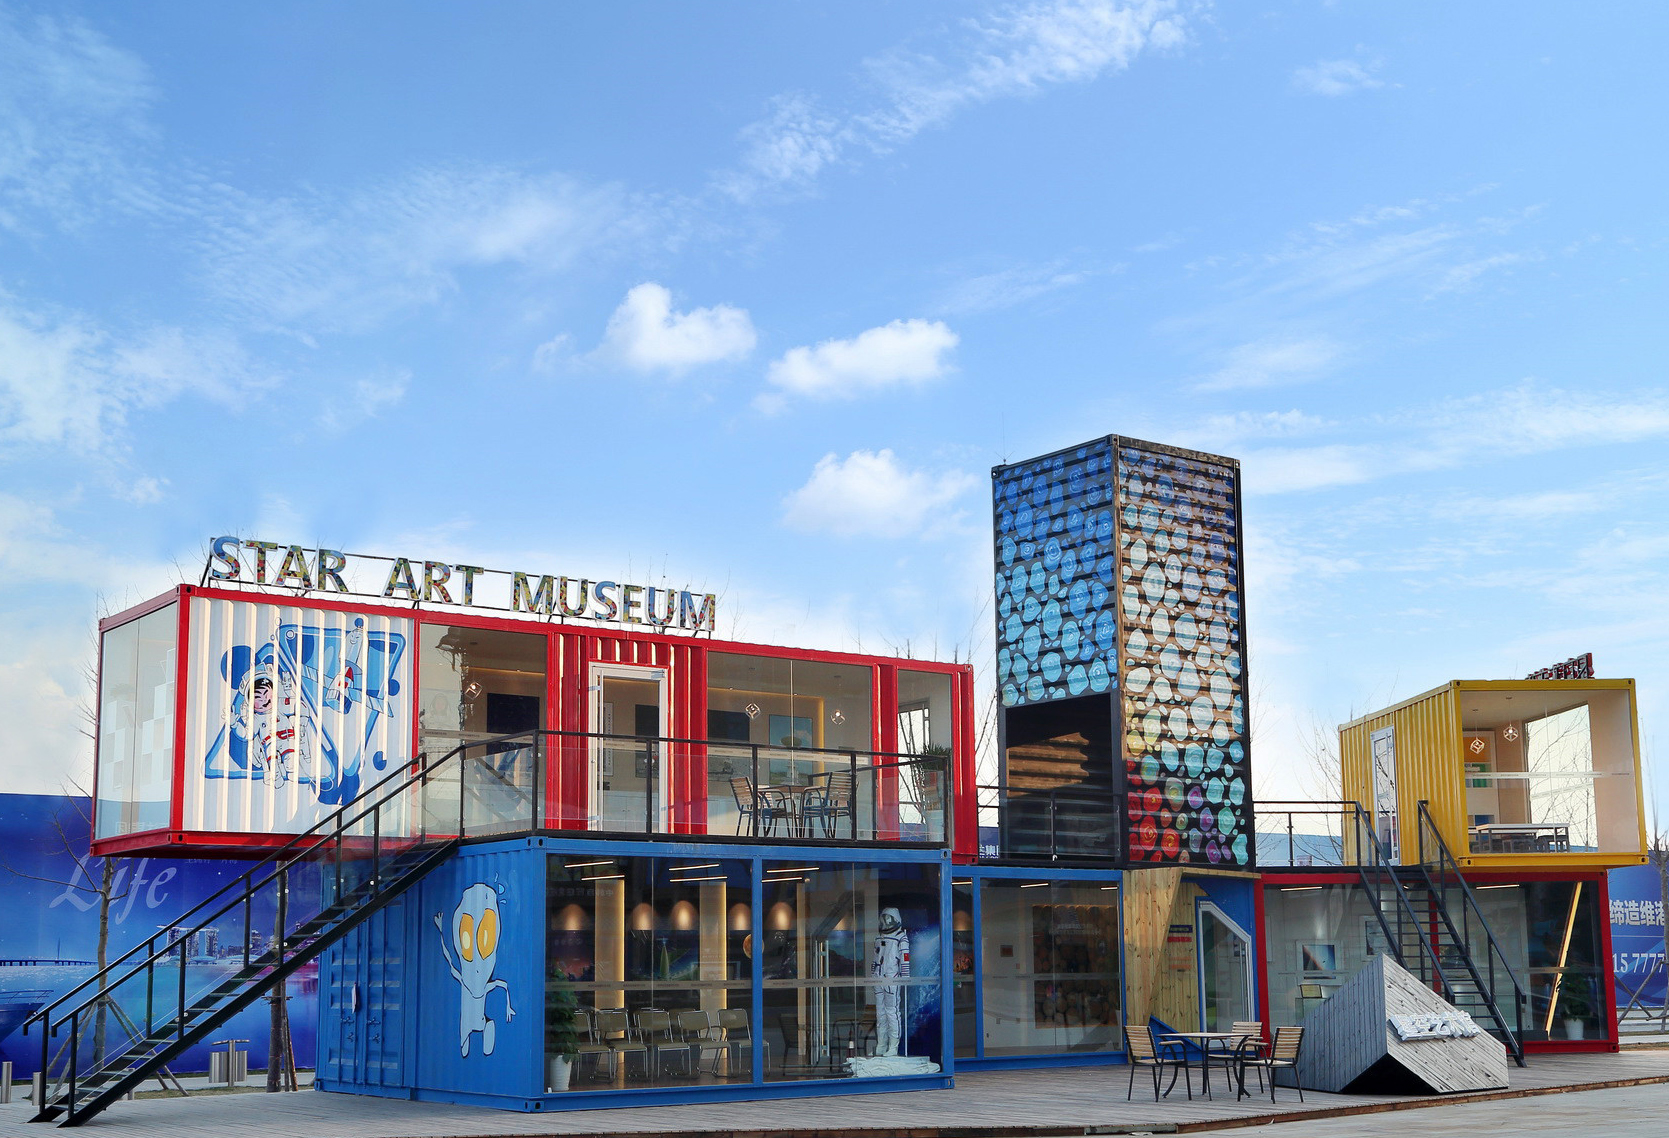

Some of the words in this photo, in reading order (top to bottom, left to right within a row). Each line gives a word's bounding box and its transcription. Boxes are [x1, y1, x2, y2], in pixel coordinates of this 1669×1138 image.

[211, 535, 348, 593] STAR
[383, 557, 484, 606] ART
[511, 571, 716, 631] MUSEUM
